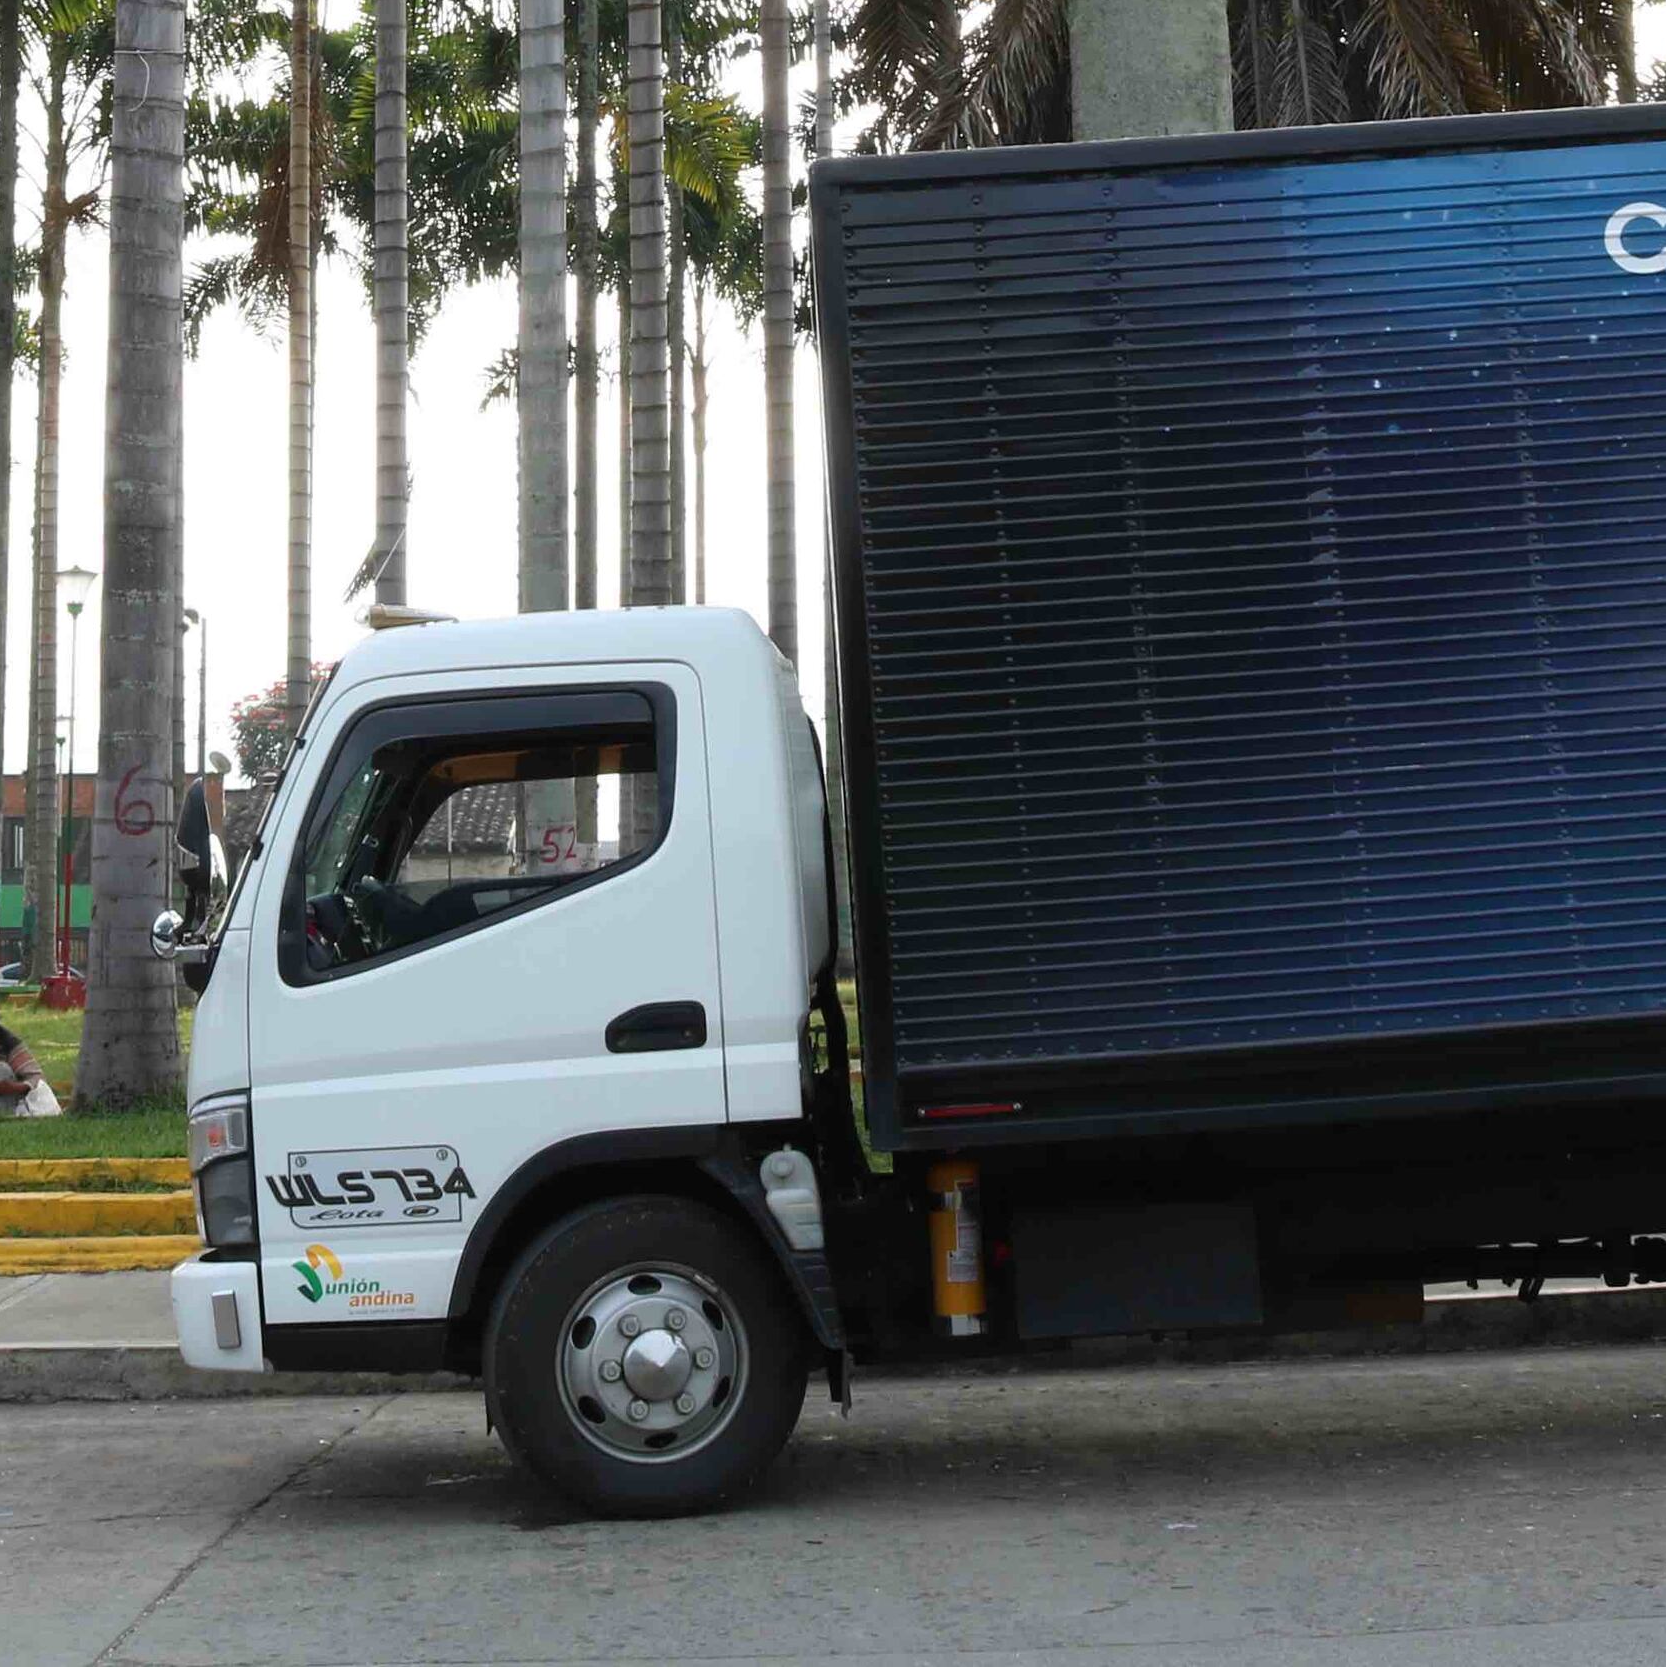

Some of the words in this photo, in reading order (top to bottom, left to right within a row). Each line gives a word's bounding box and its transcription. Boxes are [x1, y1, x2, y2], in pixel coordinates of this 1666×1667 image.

[114, 764, 155, 836] 6
[325, 1278, 380, 1295] unión
[348, 1290, 414, 1308] andina
